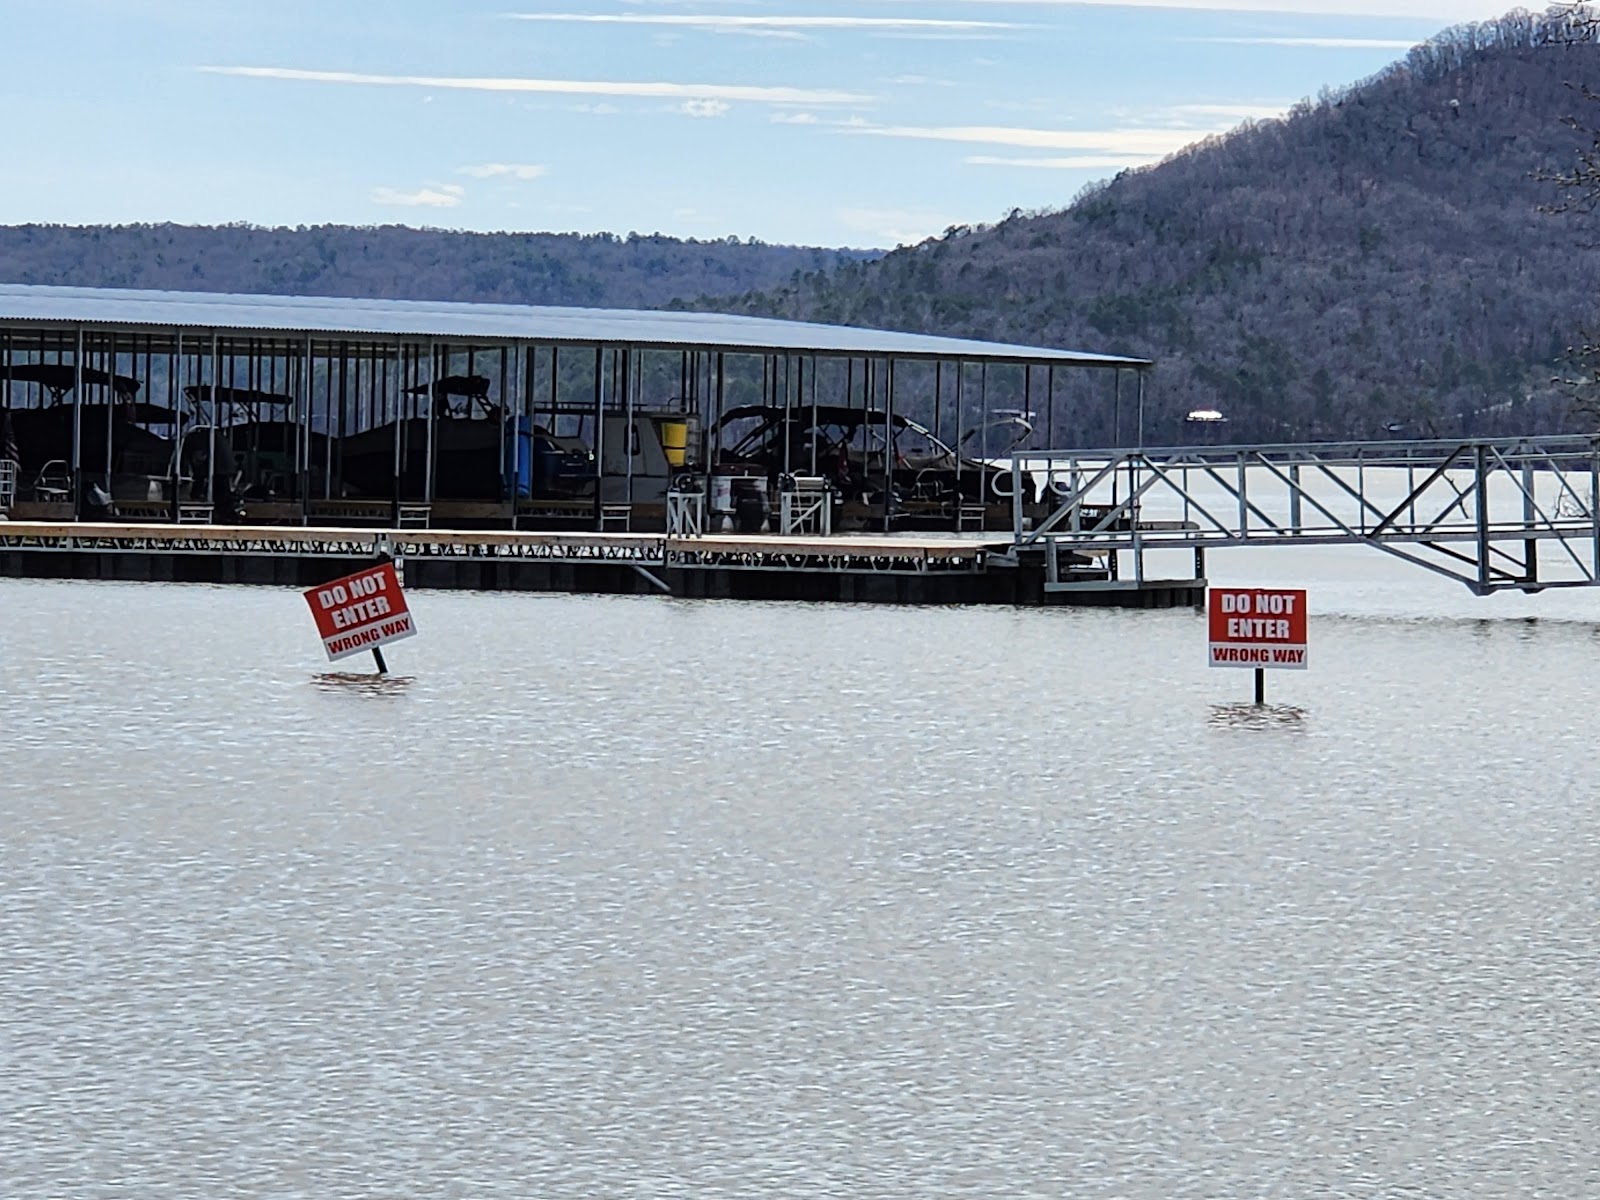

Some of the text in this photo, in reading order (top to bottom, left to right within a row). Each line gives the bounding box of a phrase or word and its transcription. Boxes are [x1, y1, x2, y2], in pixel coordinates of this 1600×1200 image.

[318, 571, 387, 609] DO NOT
[331, 596, 391, 628] ENTER
[1221, 593, 1296, 614] DO NOT
[327, 617, 410, 654] WRONG WAY
[1227, 618, 1290, 639] ENTER
[1213, 647, 1304, 663] WRONG WAY
